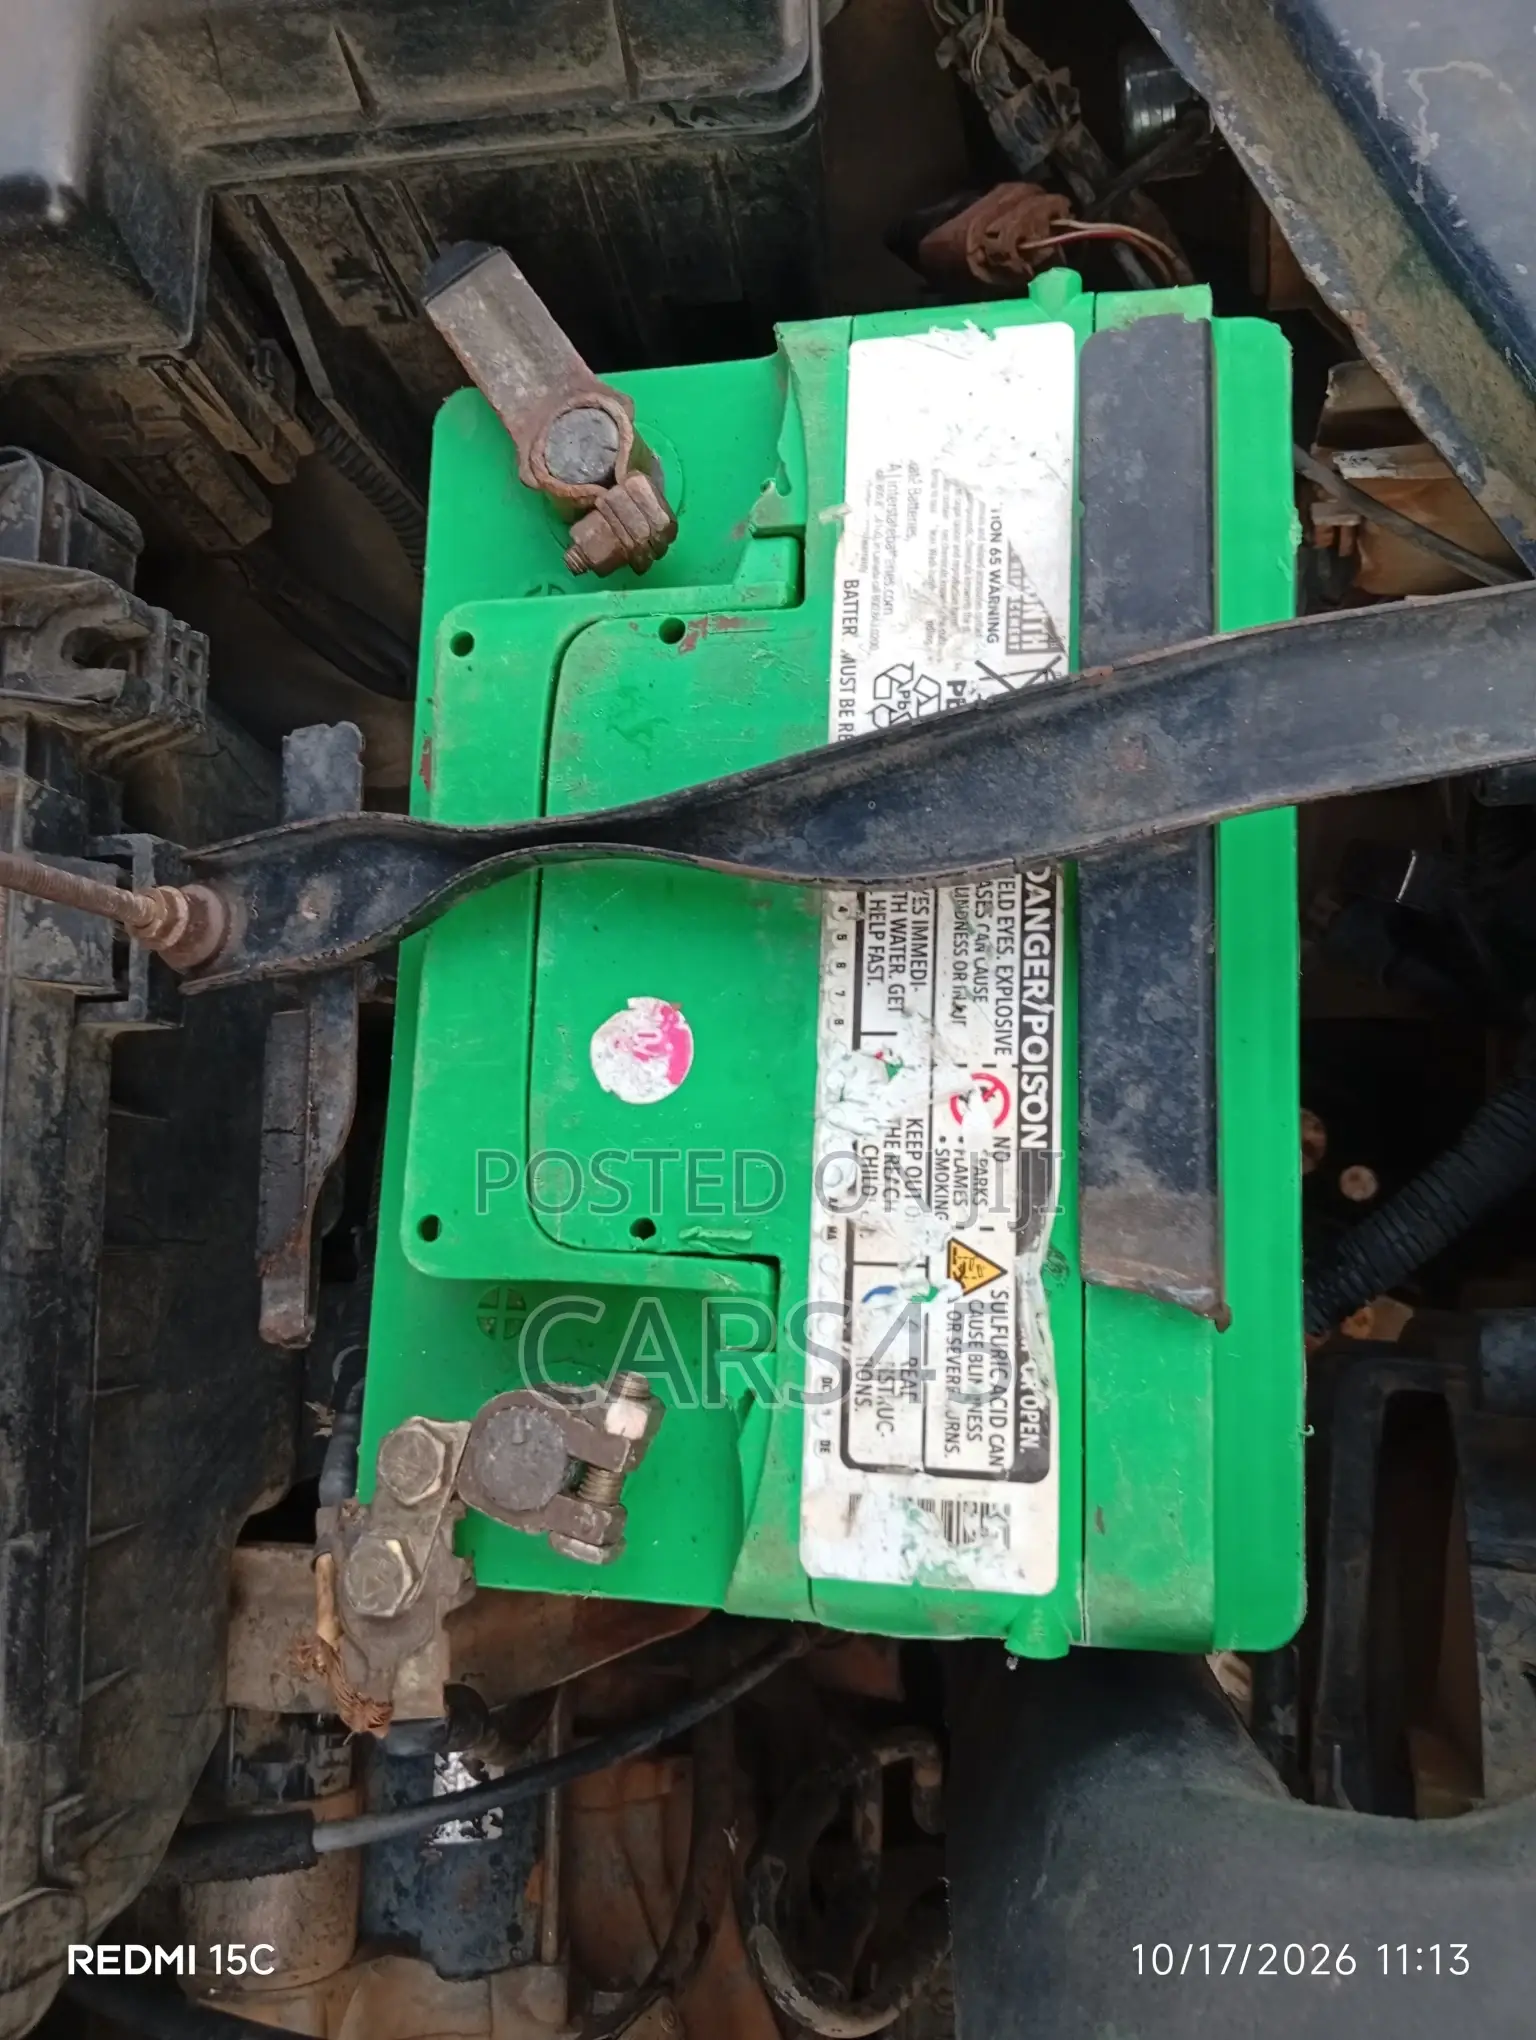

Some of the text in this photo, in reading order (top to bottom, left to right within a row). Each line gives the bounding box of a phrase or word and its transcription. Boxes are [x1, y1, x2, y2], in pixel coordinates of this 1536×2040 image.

[989, 548, 1002, 566] 65
[842, 580, 860, 637] BATTER
[986, 569, 1001, 644] WARNING
[838, 699, 855, 718] BE
[897, 690, 911, 710] Pb
[866, 900, 886, 986] HELP FAST.
[888, 918, 908, 978] WATER.
[909, 920, 928, 992] IMMEDI-
[996, 916, 1015, 960] EYES.
[952, 960, 968, 981] OR
[887, 984, 906, 1013] GET
[994, 965, 1014, 1056] EXPLOSIVE
[884, 1118, 901, 1148] THE
[906, 1118, 923, 1161] KEEP
[992, 1136, 1011, 1163] NO
[904, 1166, 922, 1200] OUT
[934, 1148, 949, 1220] SMOKING
[946, 1311, 962, 1332] OR
[966, 1300, 984, 1442] CAUSE BLINNESS
[988, 1290, 1009, 1468] SULFURIC ACID CAN
[944, 1404, 960, 1459] URNS.
[1018, 1395, 1040, 1454] OPEN.
